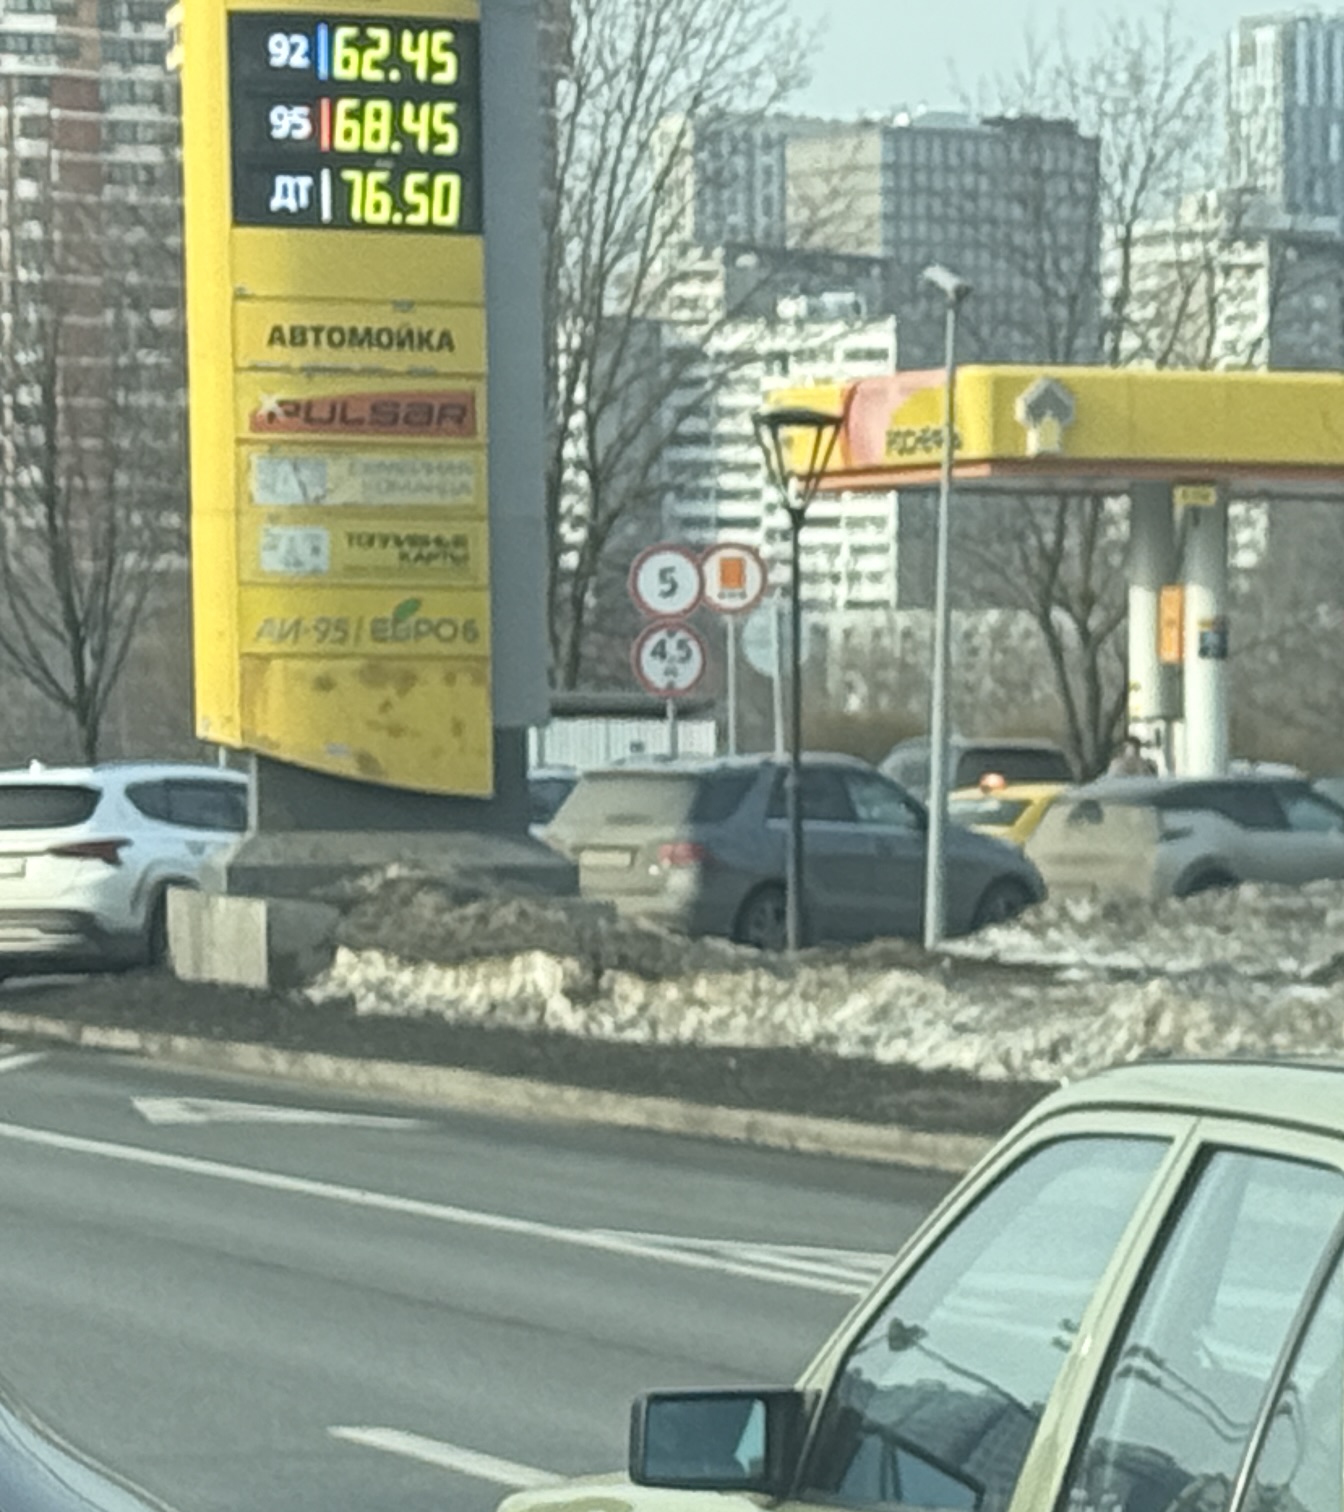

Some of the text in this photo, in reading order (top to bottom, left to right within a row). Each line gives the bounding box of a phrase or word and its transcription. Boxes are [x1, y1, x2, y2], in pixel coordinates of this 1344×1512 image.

[268, 26, 459, 85] 92 62.45
[268, 98, 459, 156] 95 68.45
[269, 169, 462, 227] ДТ 76.50
[266, 323, 456, 354] АВТОМОЙКА
[657, 565, 679, 600] 5
